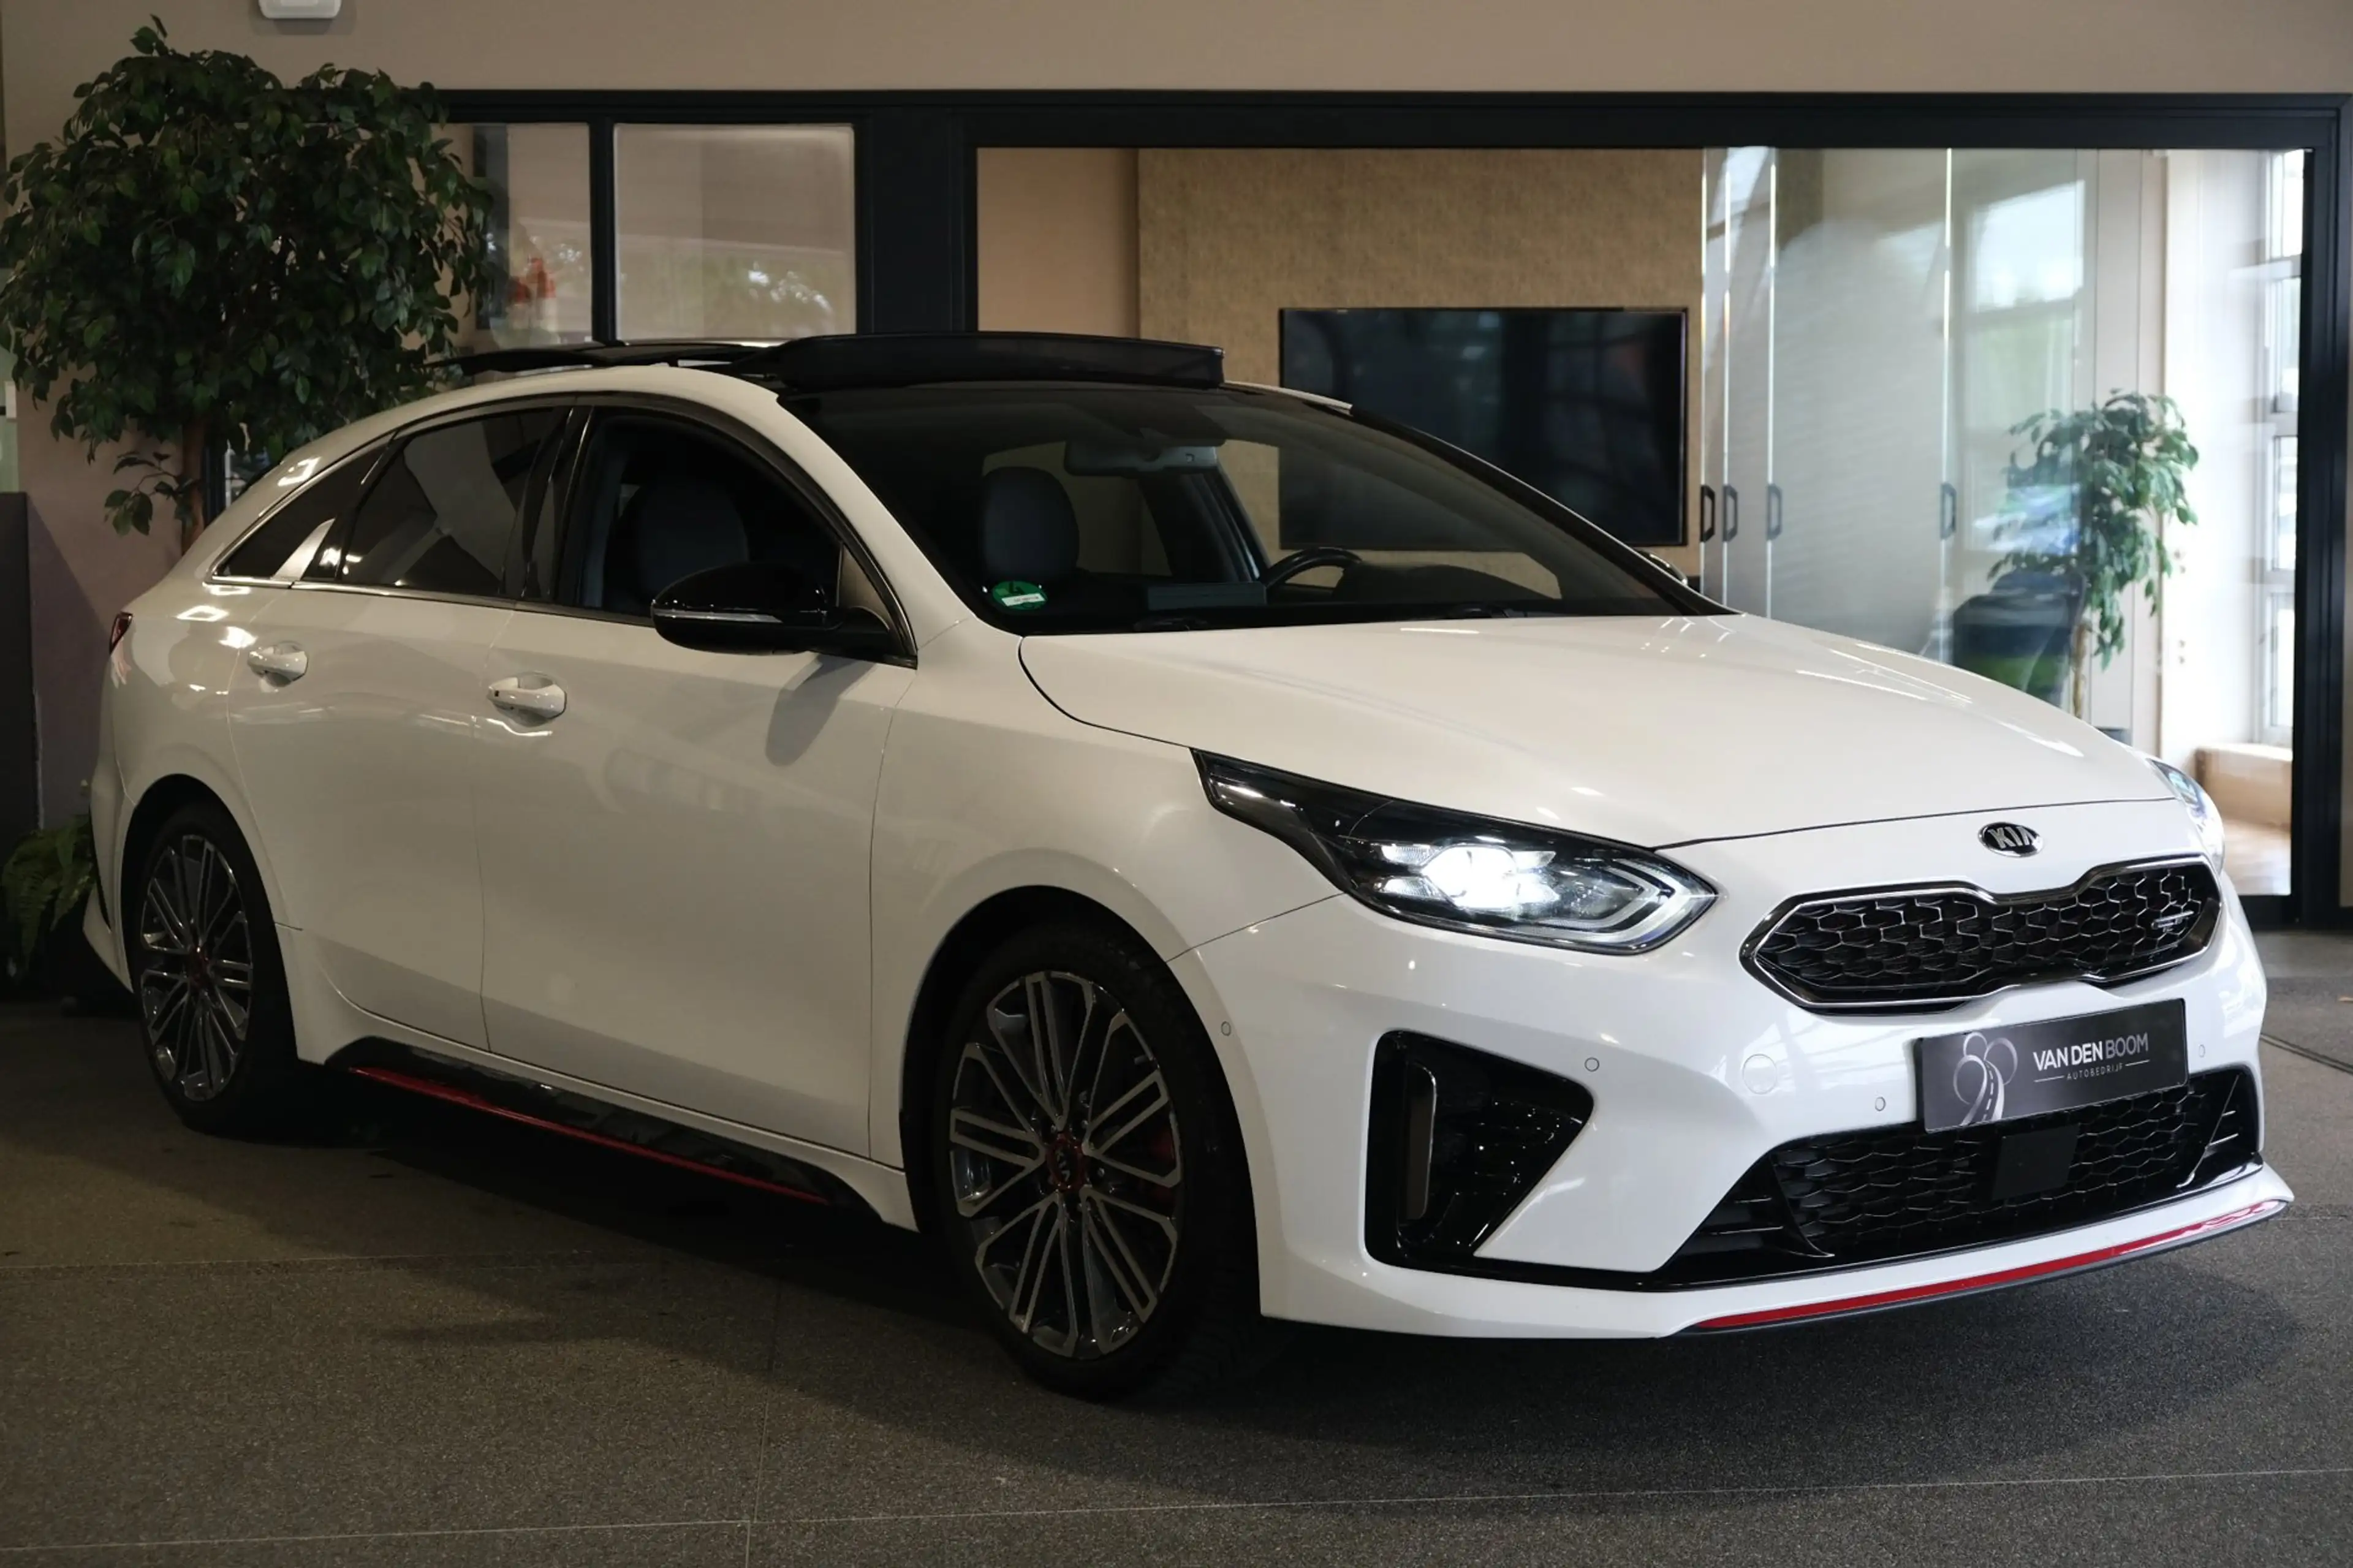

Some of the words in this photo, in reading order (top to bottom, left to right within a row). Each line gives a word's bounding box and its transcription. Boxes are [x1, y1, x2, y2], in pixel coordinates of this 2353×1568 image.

[1987, 825, 2038, 849] KIA
[2033, 1047, 2069, 1071] VAN
[2071, 1041, 2103, 1066] DEN
[2105, 1032, 2149, 1059] BOOM
[2067, 1063, 2124, 1080] AUTOBEDRIJF
